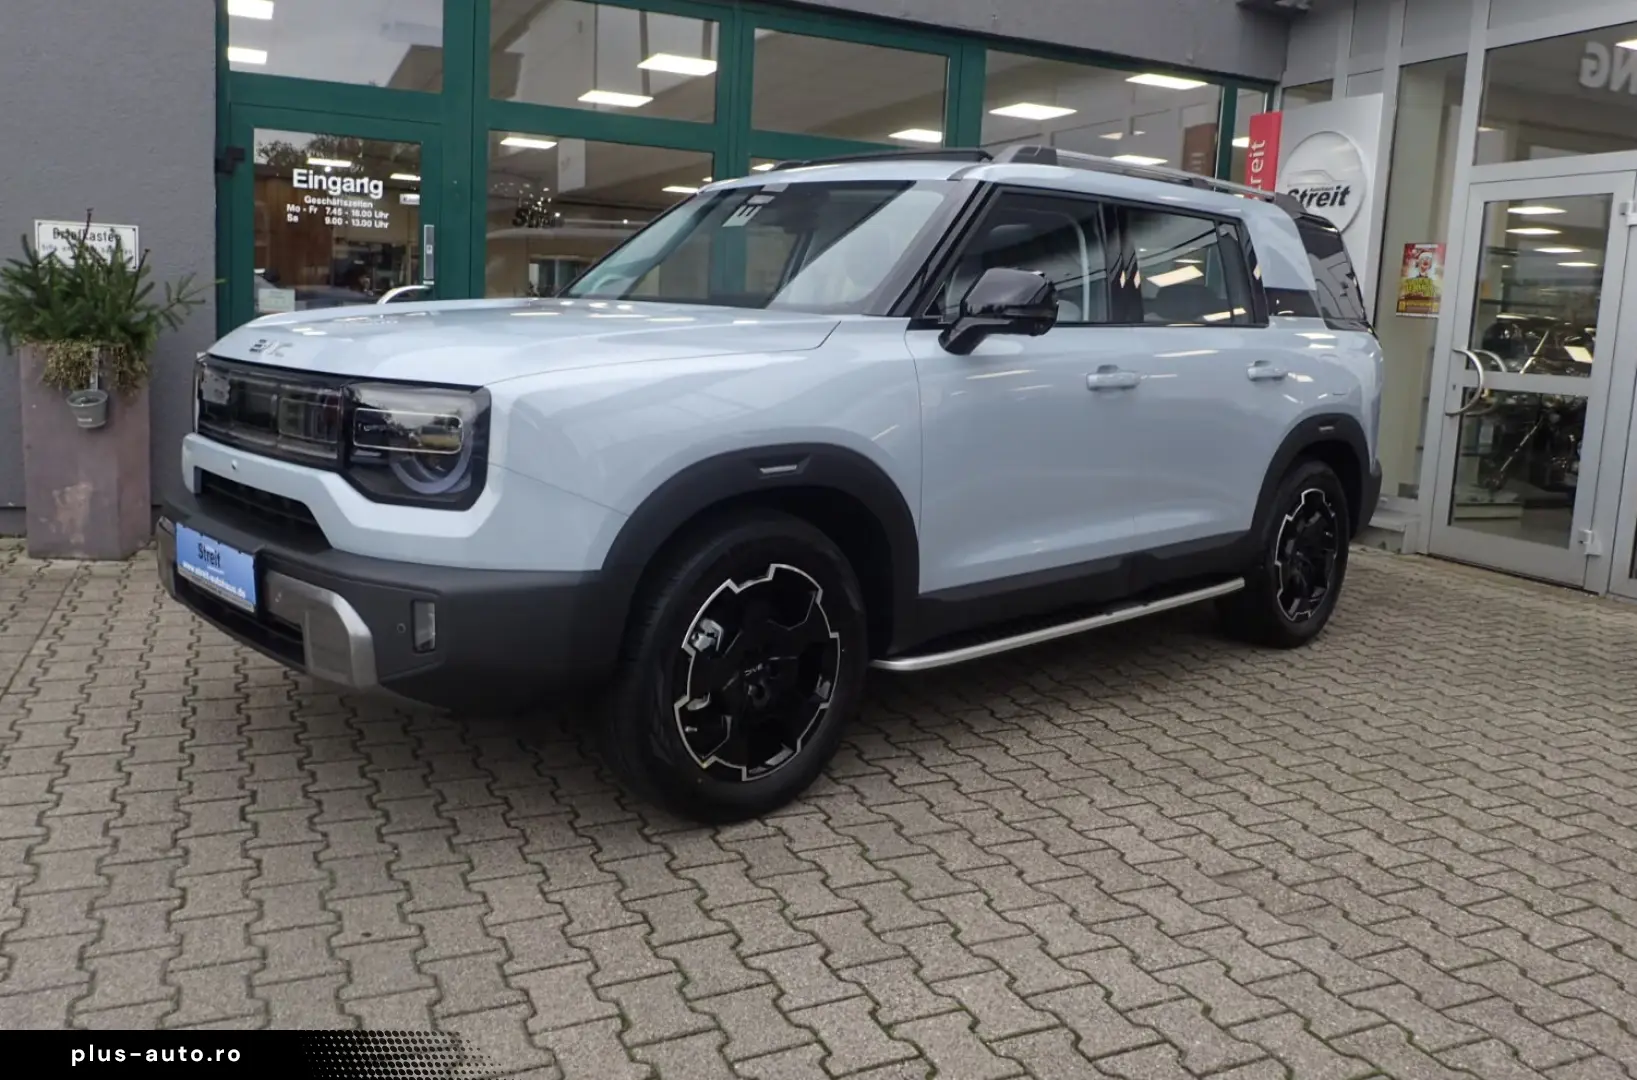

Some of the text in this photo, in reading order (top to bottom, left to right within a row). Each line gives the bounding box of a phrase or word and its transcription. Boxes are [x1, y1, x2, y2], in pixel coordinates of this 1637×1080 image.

[1249, 139, 1266, 191] reit
[292, 168, 383, 199] Eingang
[286, 203, 301, 214] Mo
[308, 205, 318, 214] Fr
[374, 211, 390, 220] Uhr
[304, 195, 374, 208] Geschäftszeiten
[287, 213, 299, 223] Sa
[325, 216, 343, 226] 9.00
[352, 218, 372, 228] 13.00
[374, 220, 390, 230] Uhr
[197, 542, 221, 568] Streit
